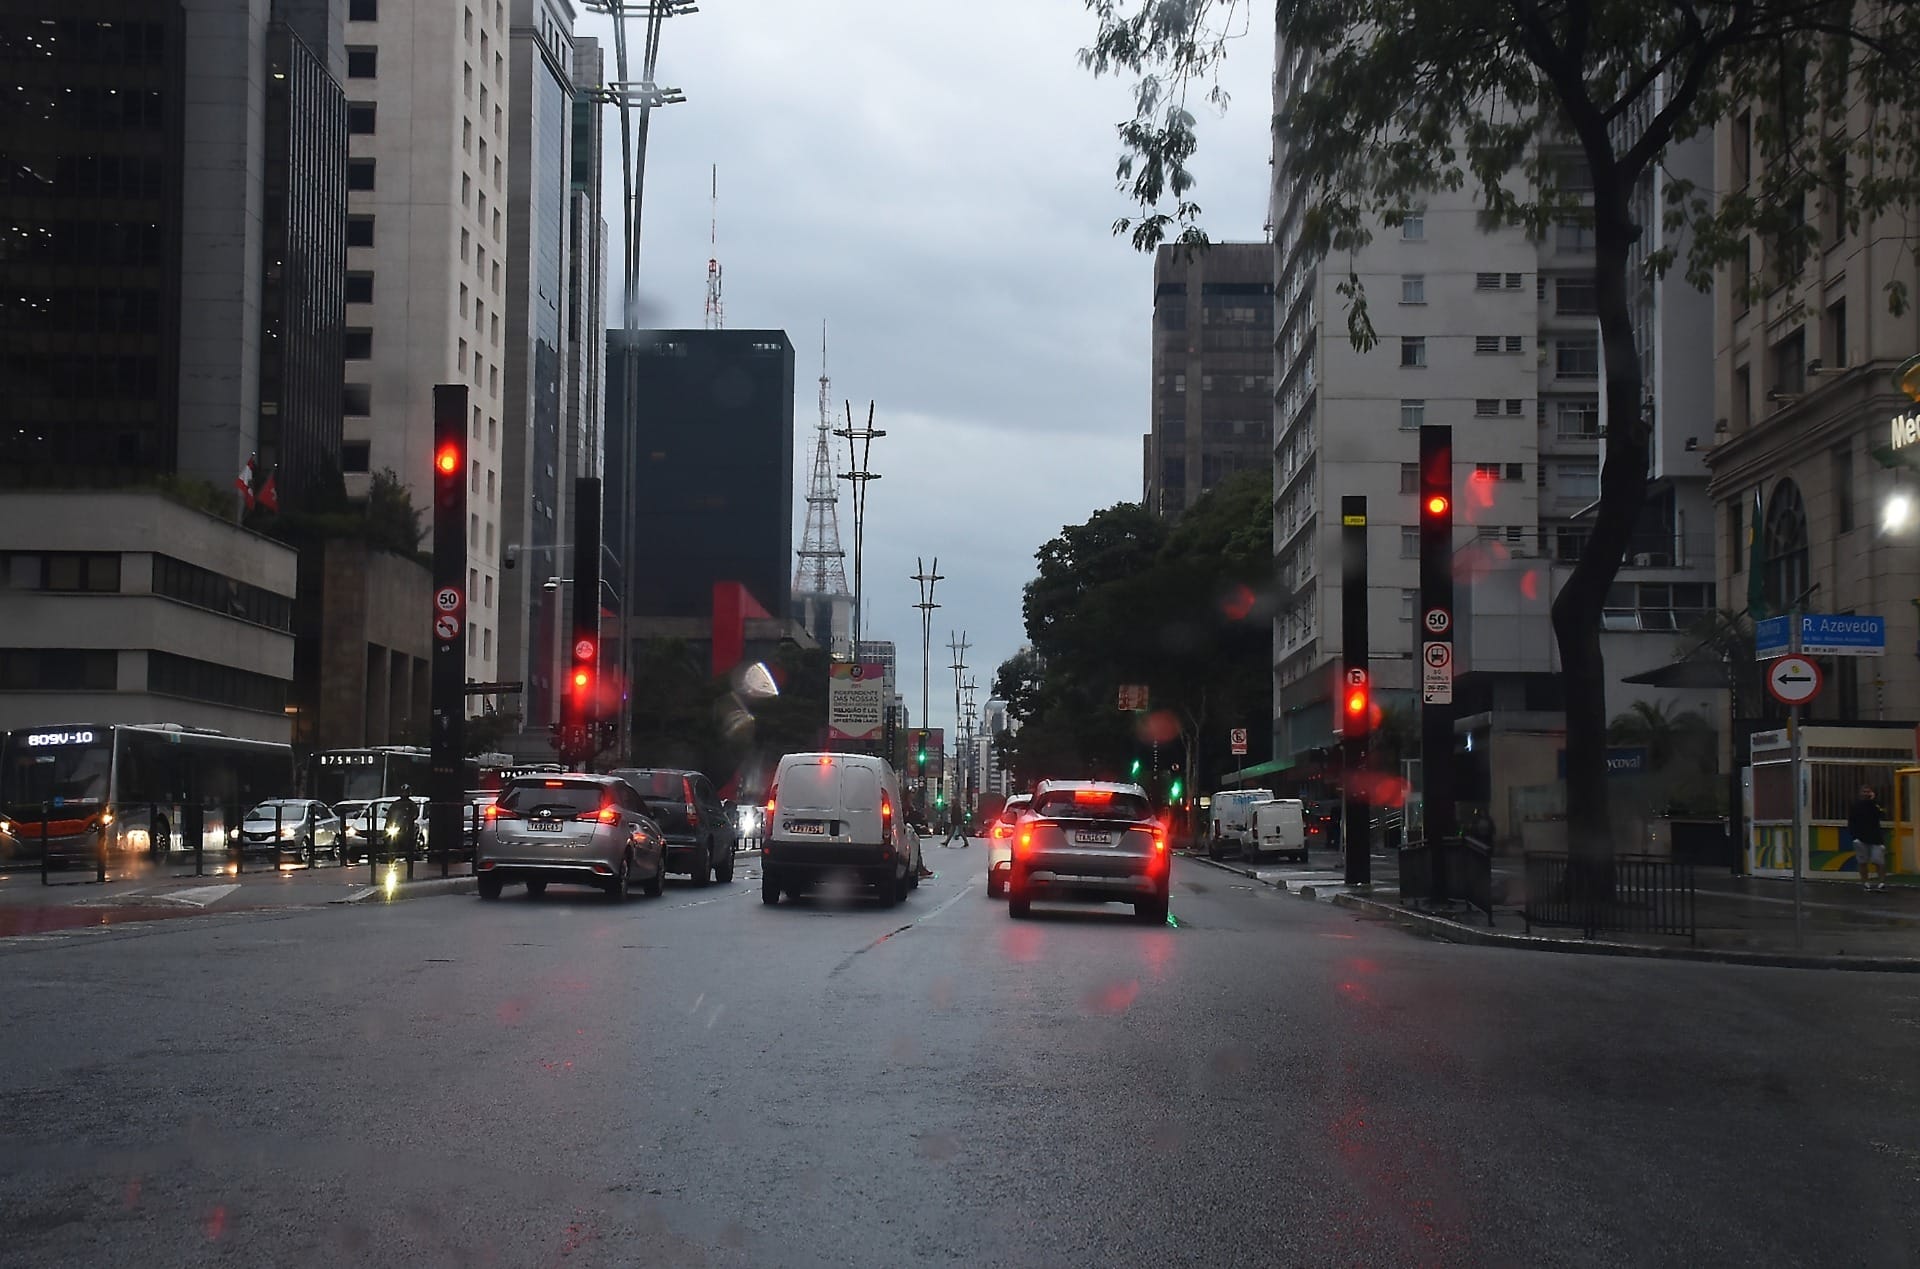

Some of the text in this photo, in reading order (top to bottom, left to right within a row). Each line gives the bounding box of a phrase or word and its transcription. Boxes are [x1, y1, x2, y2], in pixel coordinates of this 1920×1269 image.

[440, 593, 456, 604] 50
[1428, 613, 1446, 625] 50
[1803, 618, 1878, 633] R. Azevedo
[28, 731, 93, 746] 809V-10
[1606, 755, 1641, 772] ycoval
